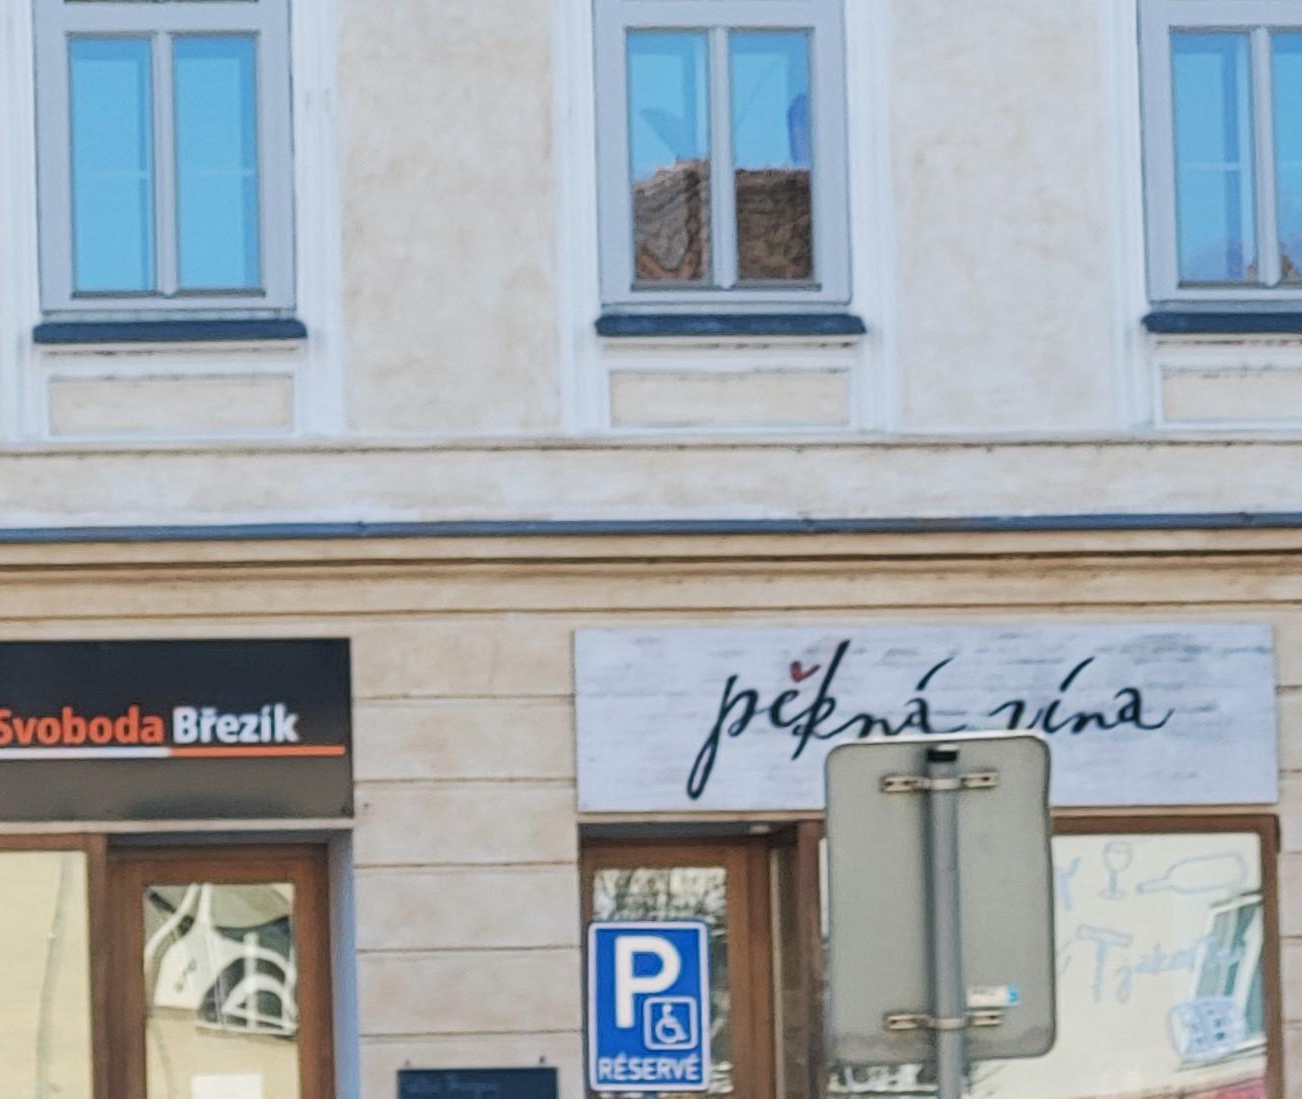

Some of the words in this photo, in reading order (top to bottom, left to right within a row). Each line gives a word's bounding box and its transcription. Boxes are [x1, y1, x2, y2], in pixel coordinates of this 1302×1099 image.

[173, 702, 301, 744] Březík
[687, 639, 969, 800] pěkná
[615, 934, 682, 1029] P
[598, 1051, 702, 1082] RÉSERVÉ
